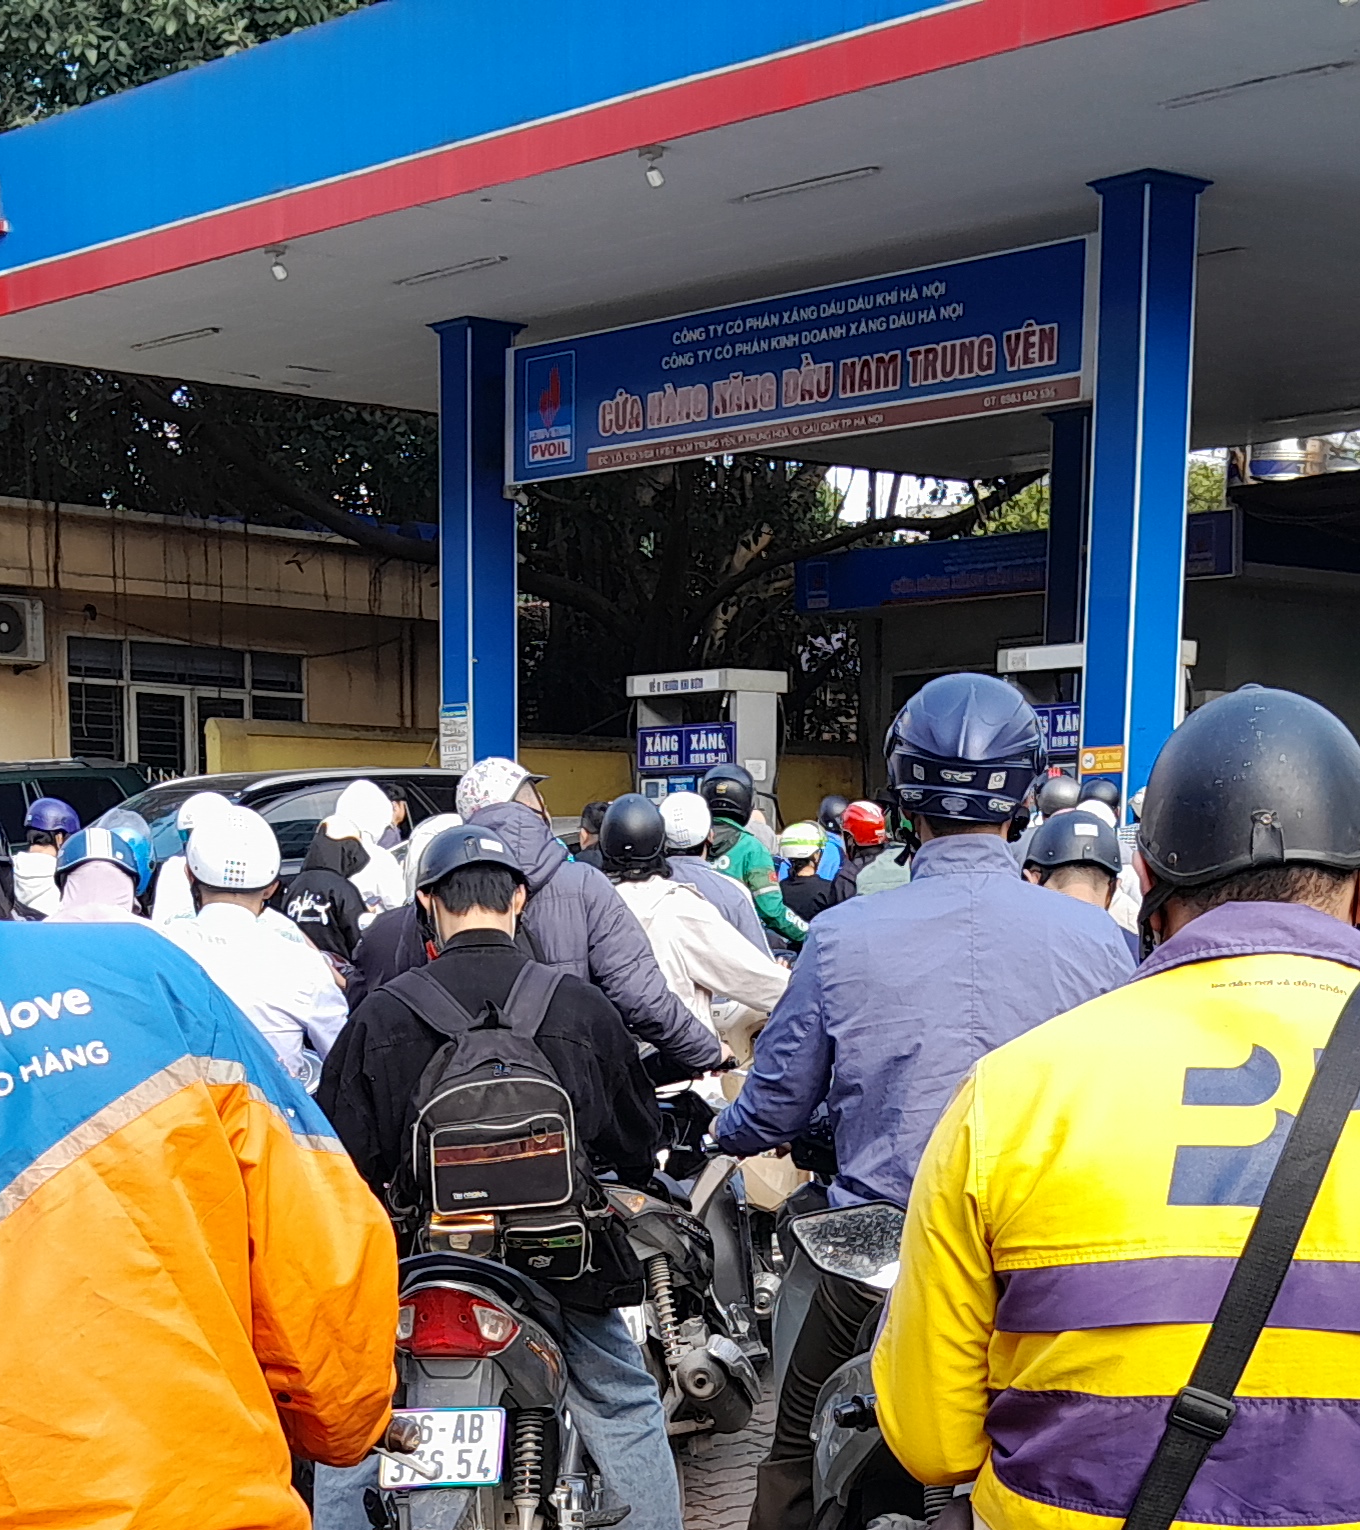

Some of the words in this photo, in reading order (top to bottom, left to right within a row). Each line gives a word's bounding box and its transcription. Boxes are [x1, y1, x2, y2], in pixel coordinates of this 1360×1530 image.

[661, 352, 695, 370] CÔNG
[697, 349, 713, 363] TY
[771, 333, 800, 350] KINH
[801, 325, 846, 346] DOANH
[918, 305, 937, 324] HÀ
[940, 303, 964, 321] NỘI
[672, 327, 706, 345] CÔNG
[708, 324, 724, 339] TY
[900, 284, 919, 303] HÀ
[922, 280, 946, 300] NỘI
[598, 388, 644, 437] CỬA
[647, 382, 709, 429] HÀNG
[839, 350, 902, 398] NAM
[907, 334, 997, 387] TRUNG
[1003, 319, 1059, 372] YÊN
[531, 441, 568, 460] PVOIL
[407, 1413, 485, 1445] 6-AB
